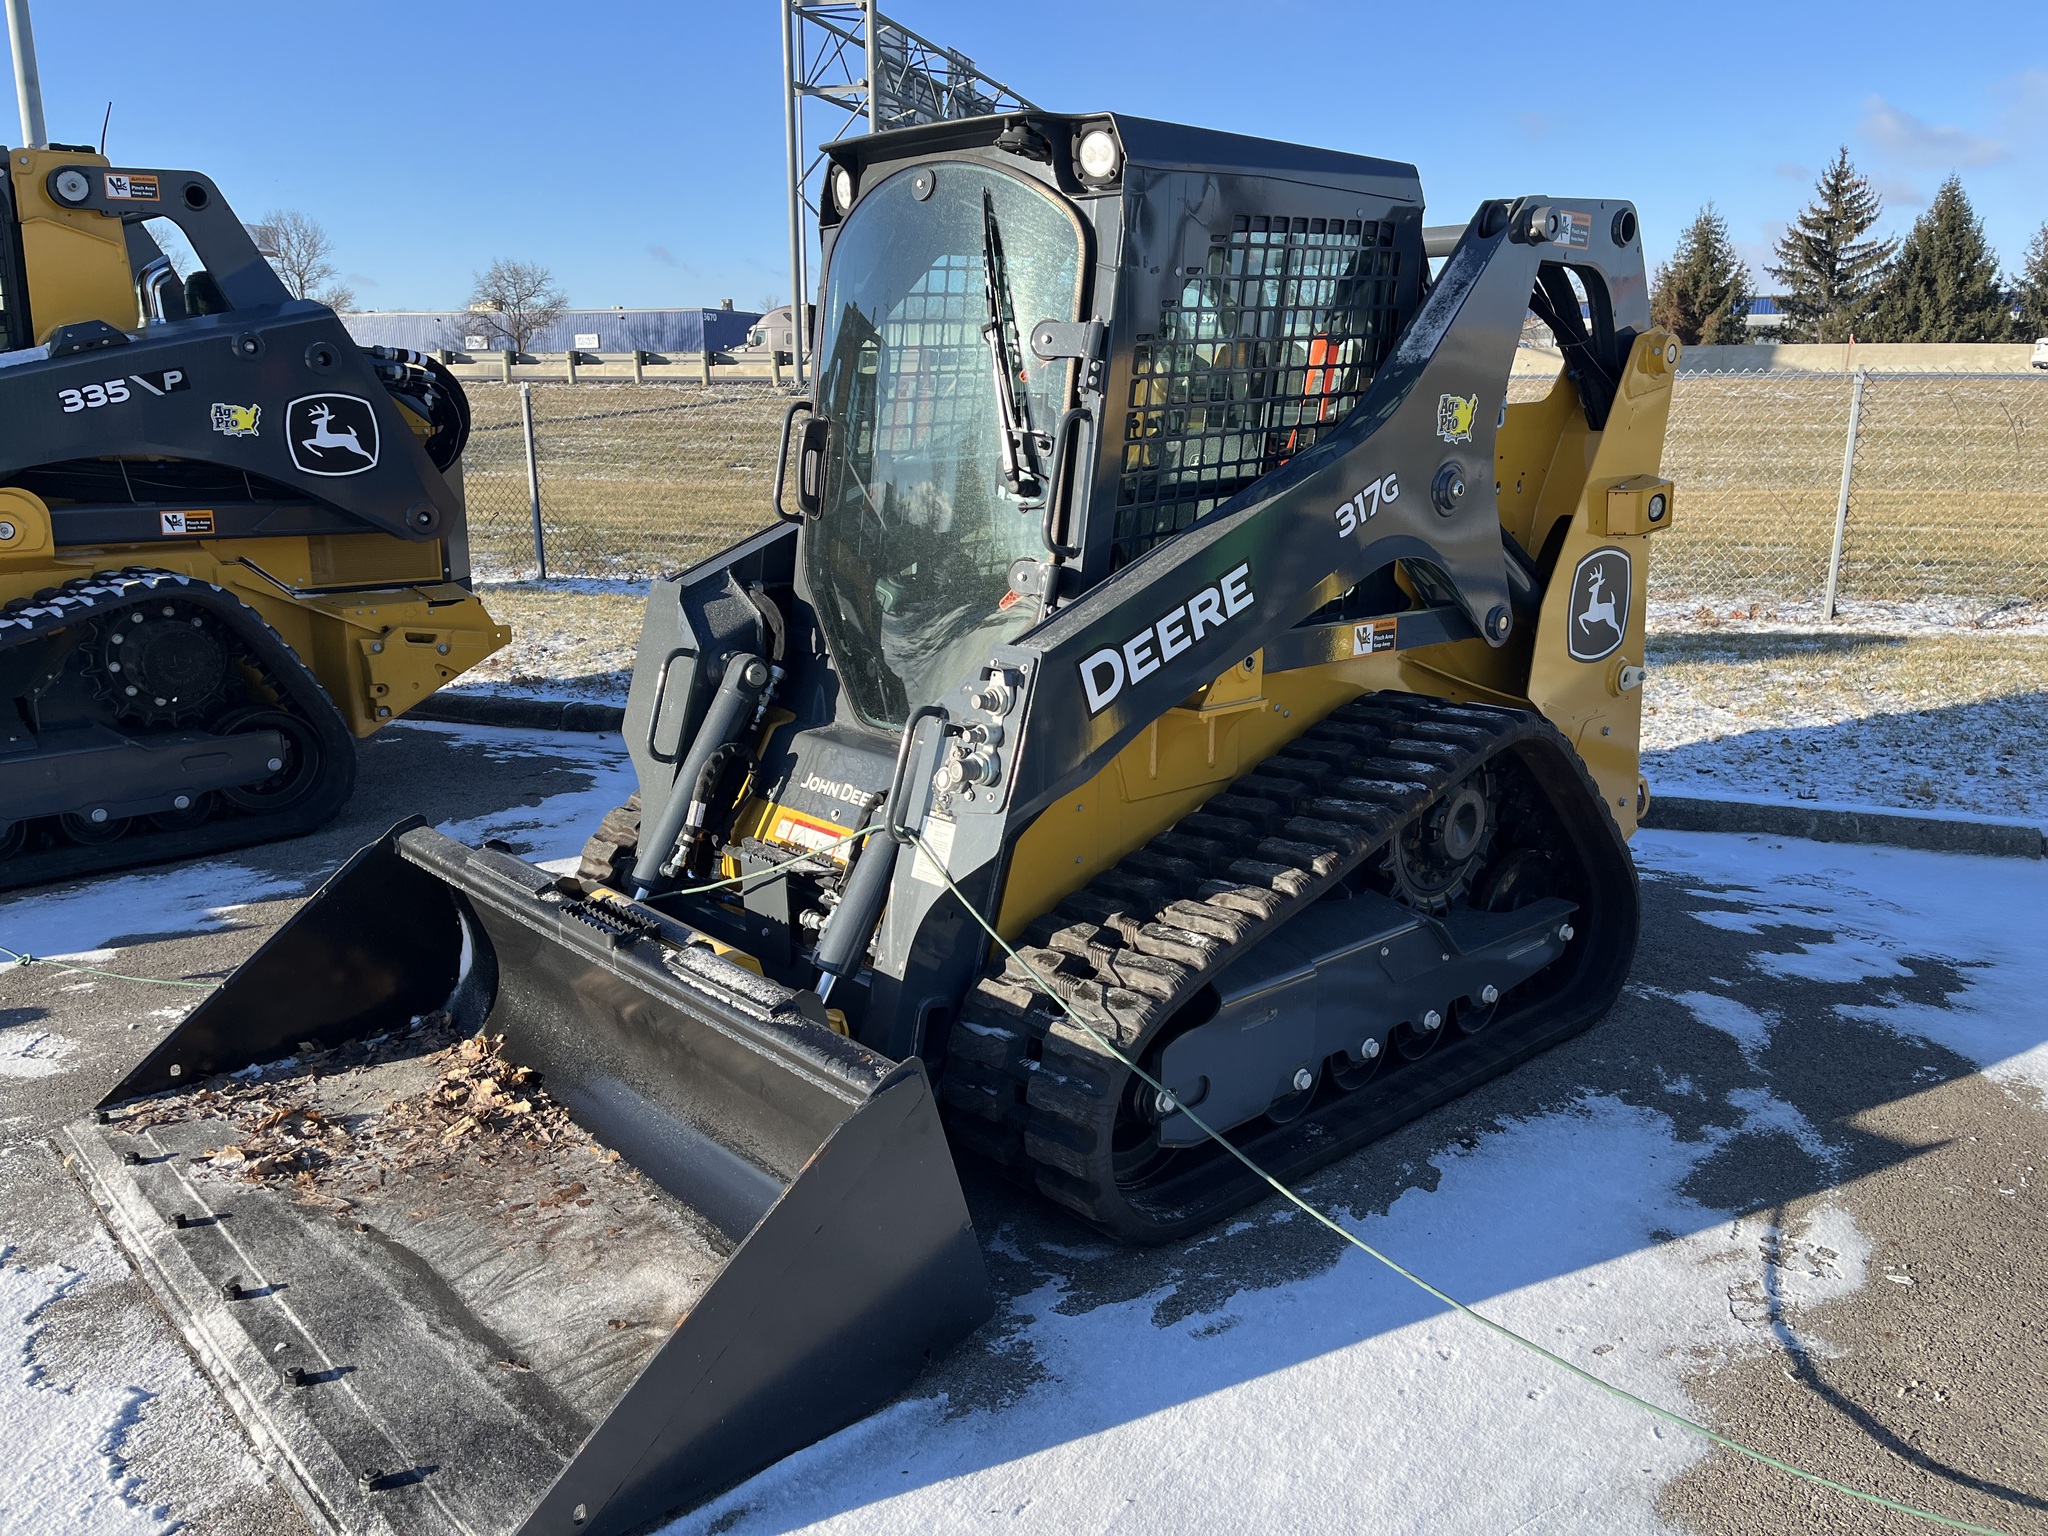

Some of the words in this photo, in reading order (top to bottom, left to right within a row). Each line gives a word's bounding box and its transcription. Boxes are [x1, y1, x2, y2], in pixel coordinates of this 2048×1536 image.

[58, 378, 131, 413] 335
[163, 370, 183, 391] P
[214, 406, 237, 418] Ag-
[215, 417, 238, 428] Pro
[1440, 398, 1459, 417] Ag-
[1440, 415, 1458, 431] Pro
[1335, 473, 1400, 538] 317G
[1079, 562, 1255, 715] DEERE
[800, 772, 841, 798] JOHN
[839, 783, 884, 813] DEE
